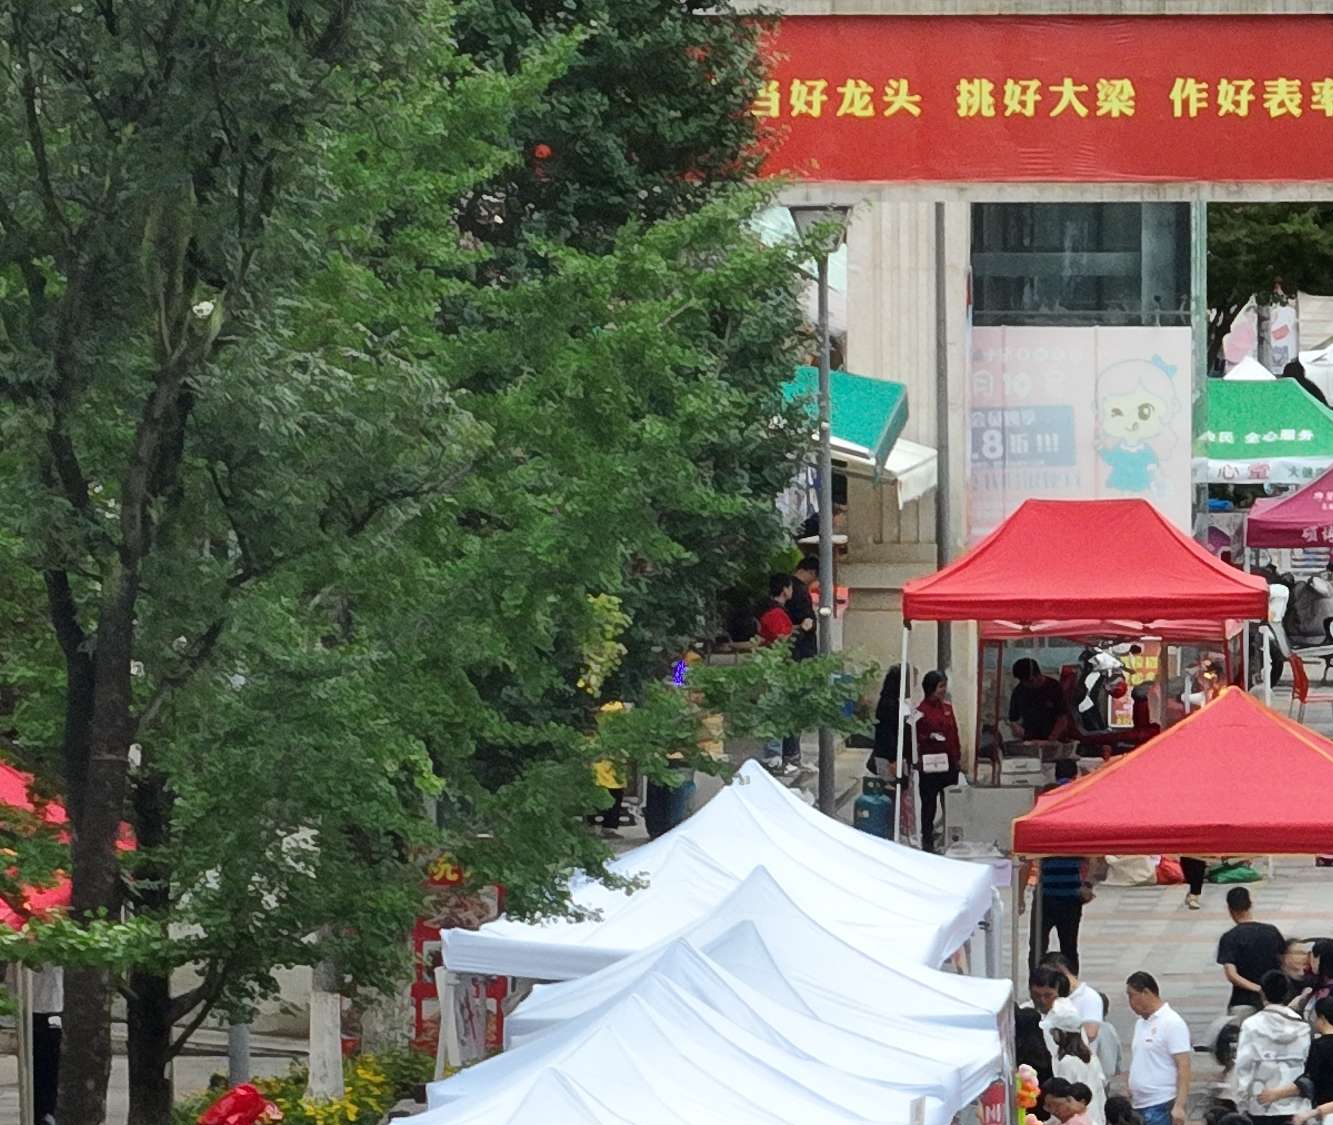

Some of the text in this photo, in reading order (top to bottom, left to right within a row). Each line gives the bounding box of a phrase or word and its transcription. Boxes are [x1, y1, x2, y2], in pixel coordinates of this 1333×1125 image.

[751, 78, 922, 118] 当好龙头
[956, 78, 1137, 118] 挑好大梁
